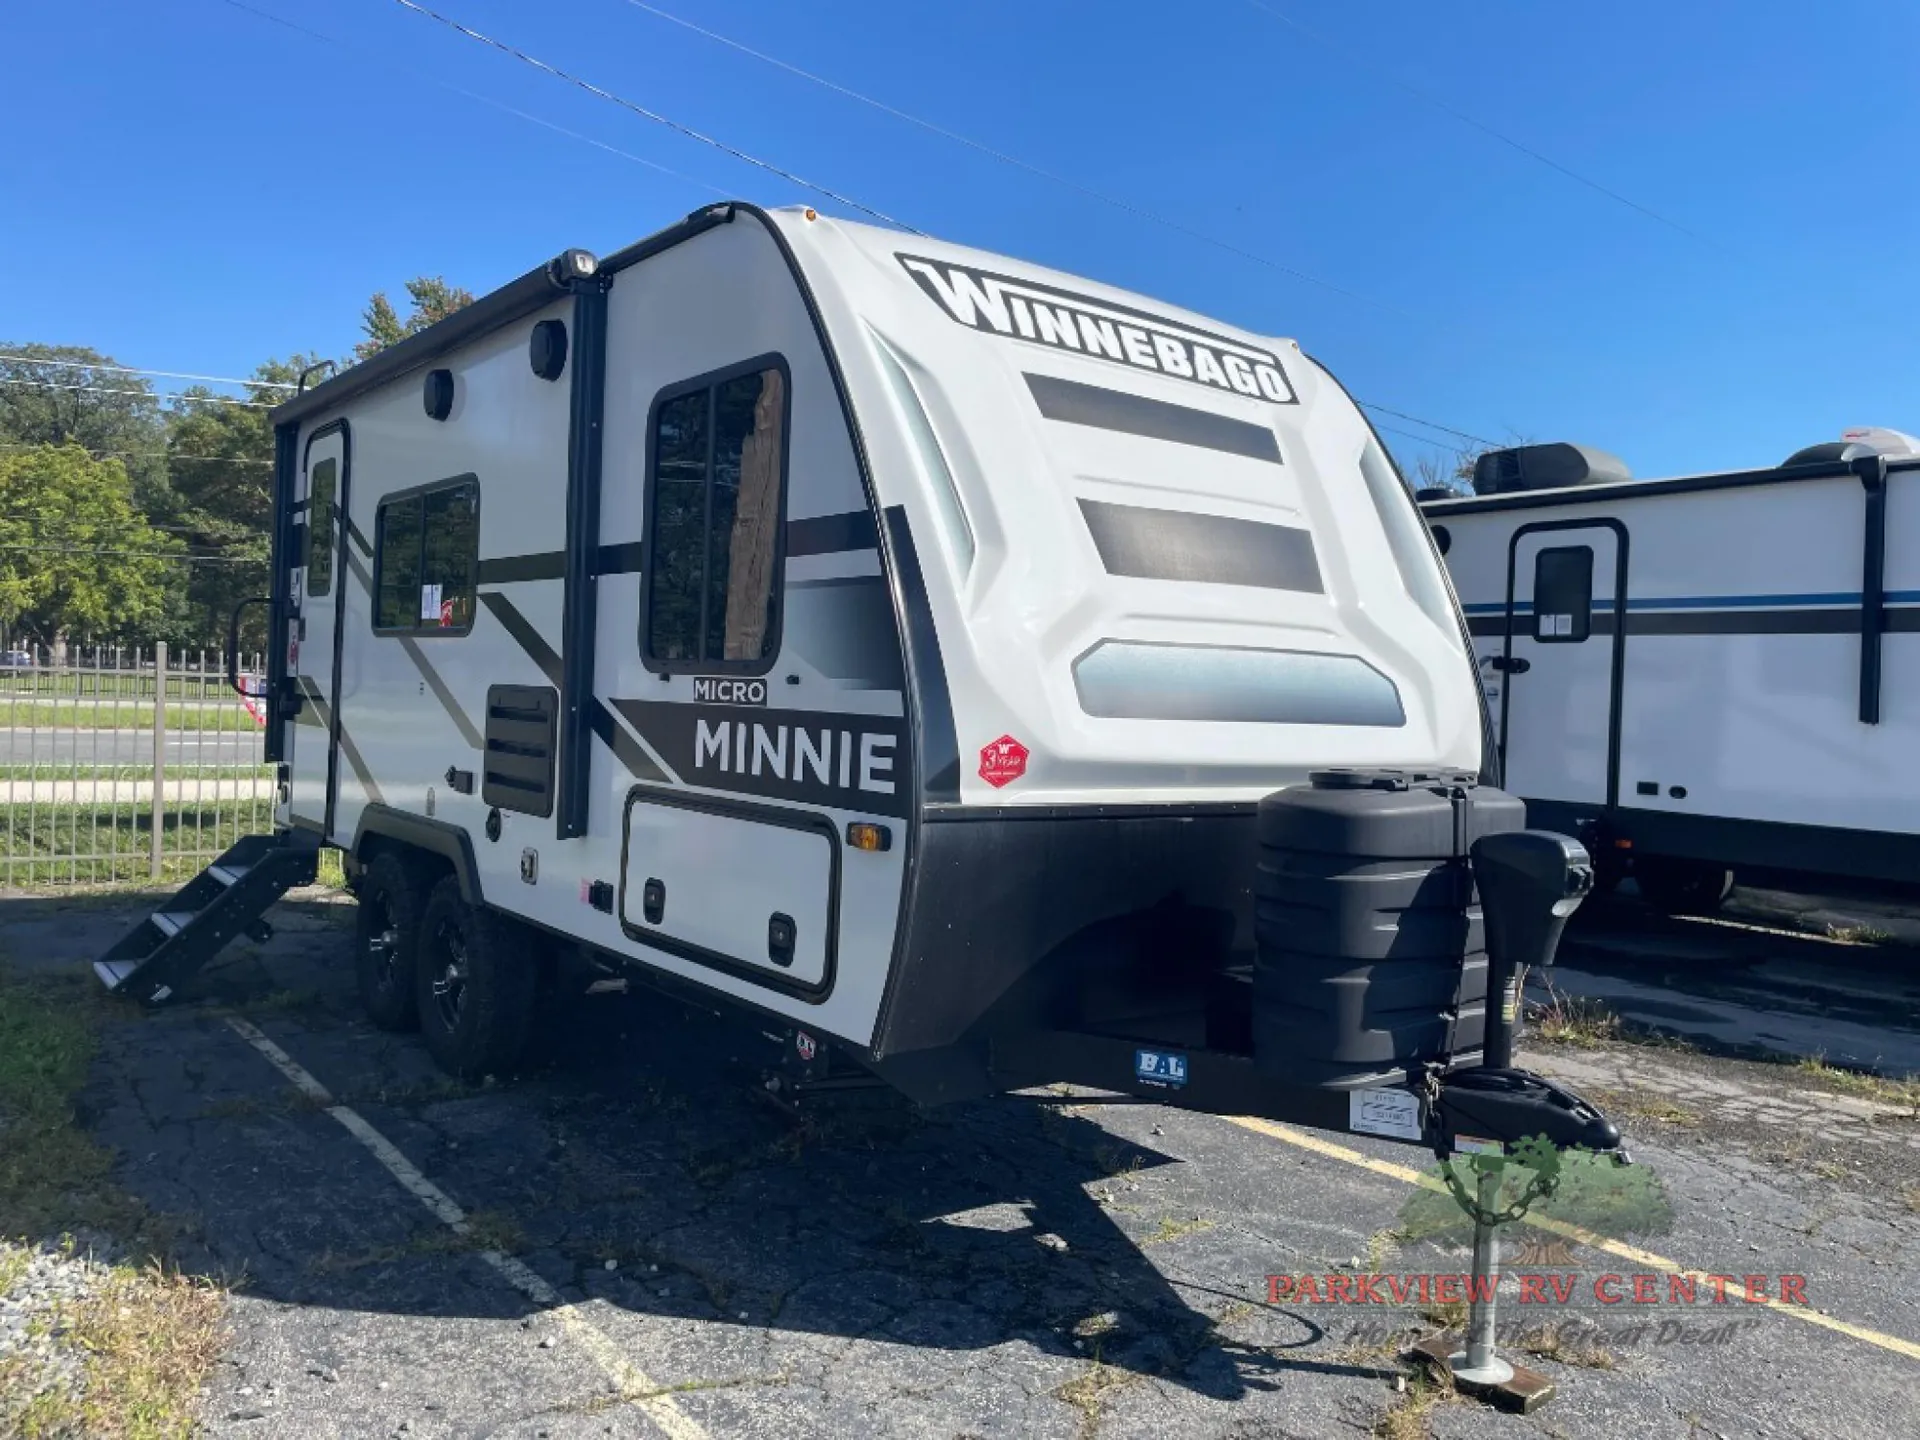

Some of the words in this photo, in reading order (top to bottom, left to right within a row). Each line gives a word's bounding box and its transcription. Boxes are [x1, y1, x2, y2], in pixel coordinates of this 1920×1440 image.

[904, 258, 1291, 402] WINNEBAGO
[694, 679, 765, 702] MICRO
[695, 719, 897, 794] MINNIE
